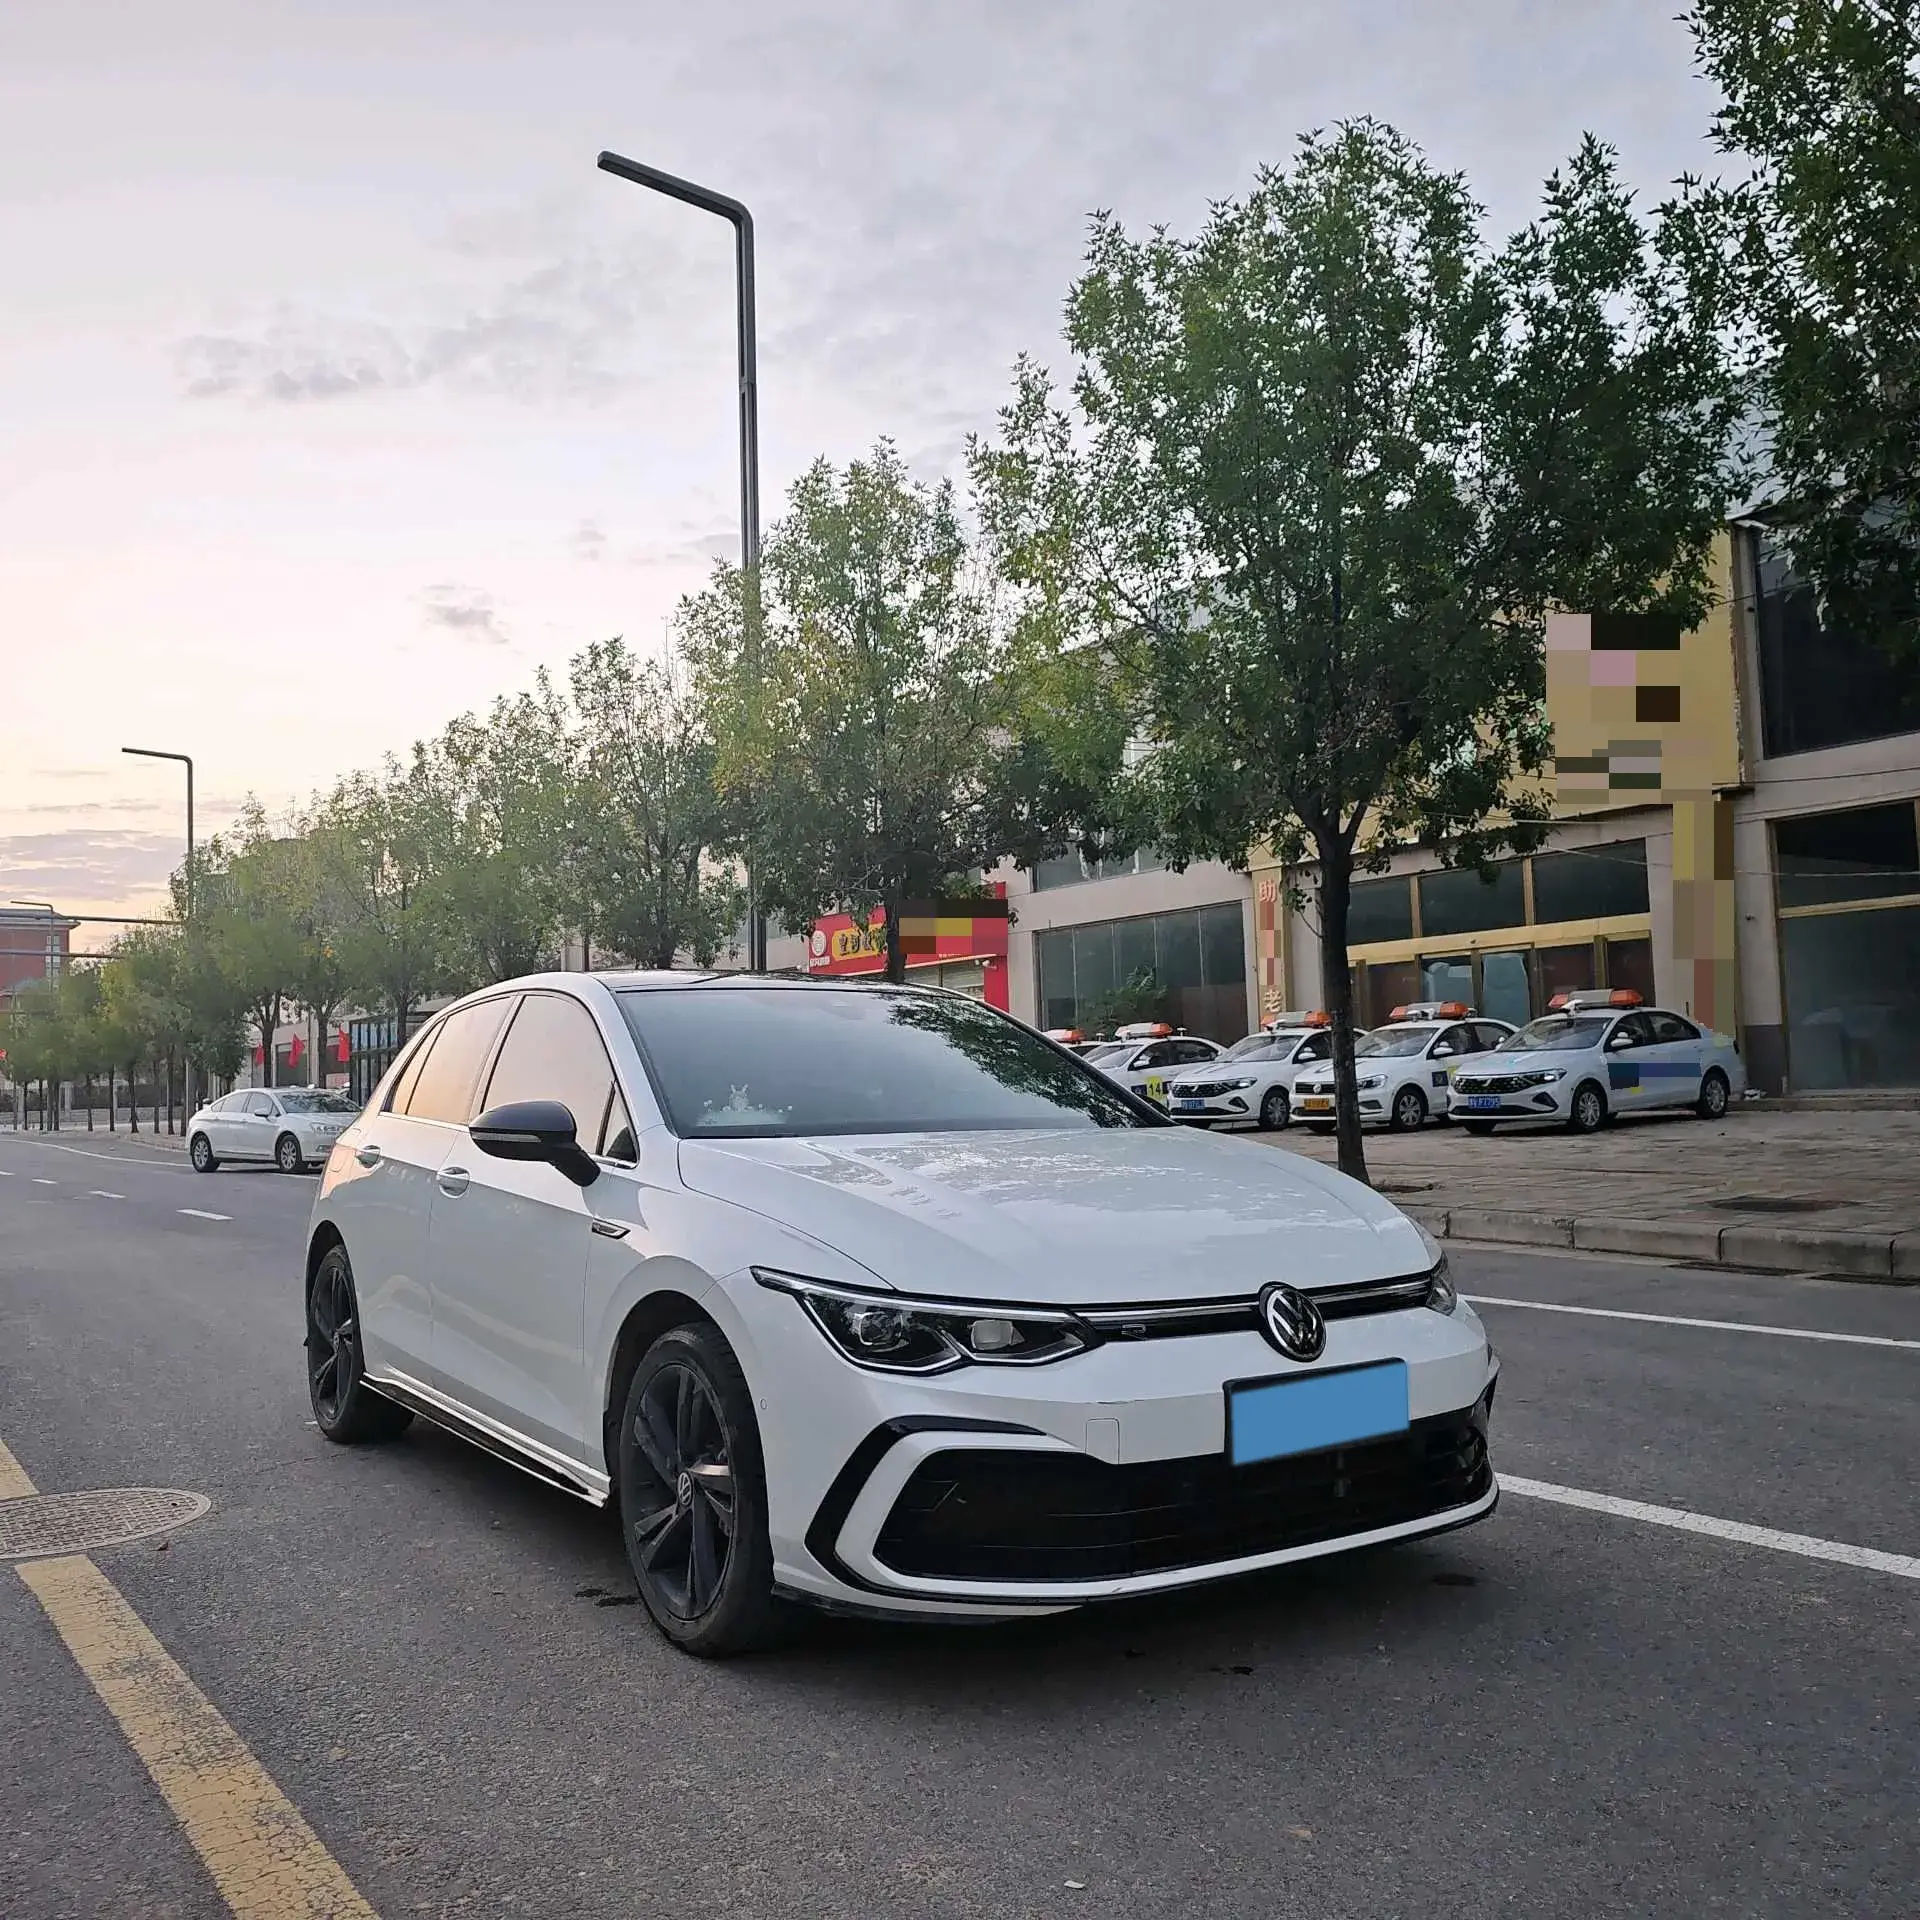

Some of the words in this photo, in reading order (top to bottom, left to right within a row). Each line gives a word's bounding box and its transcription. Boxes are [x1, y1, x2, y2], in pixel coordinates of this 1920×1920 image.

[1259, 880, 1277, 903] 助
[1264, 989, 1282, 1013] 老
[1148, 1082, 1161, 1096] 14
